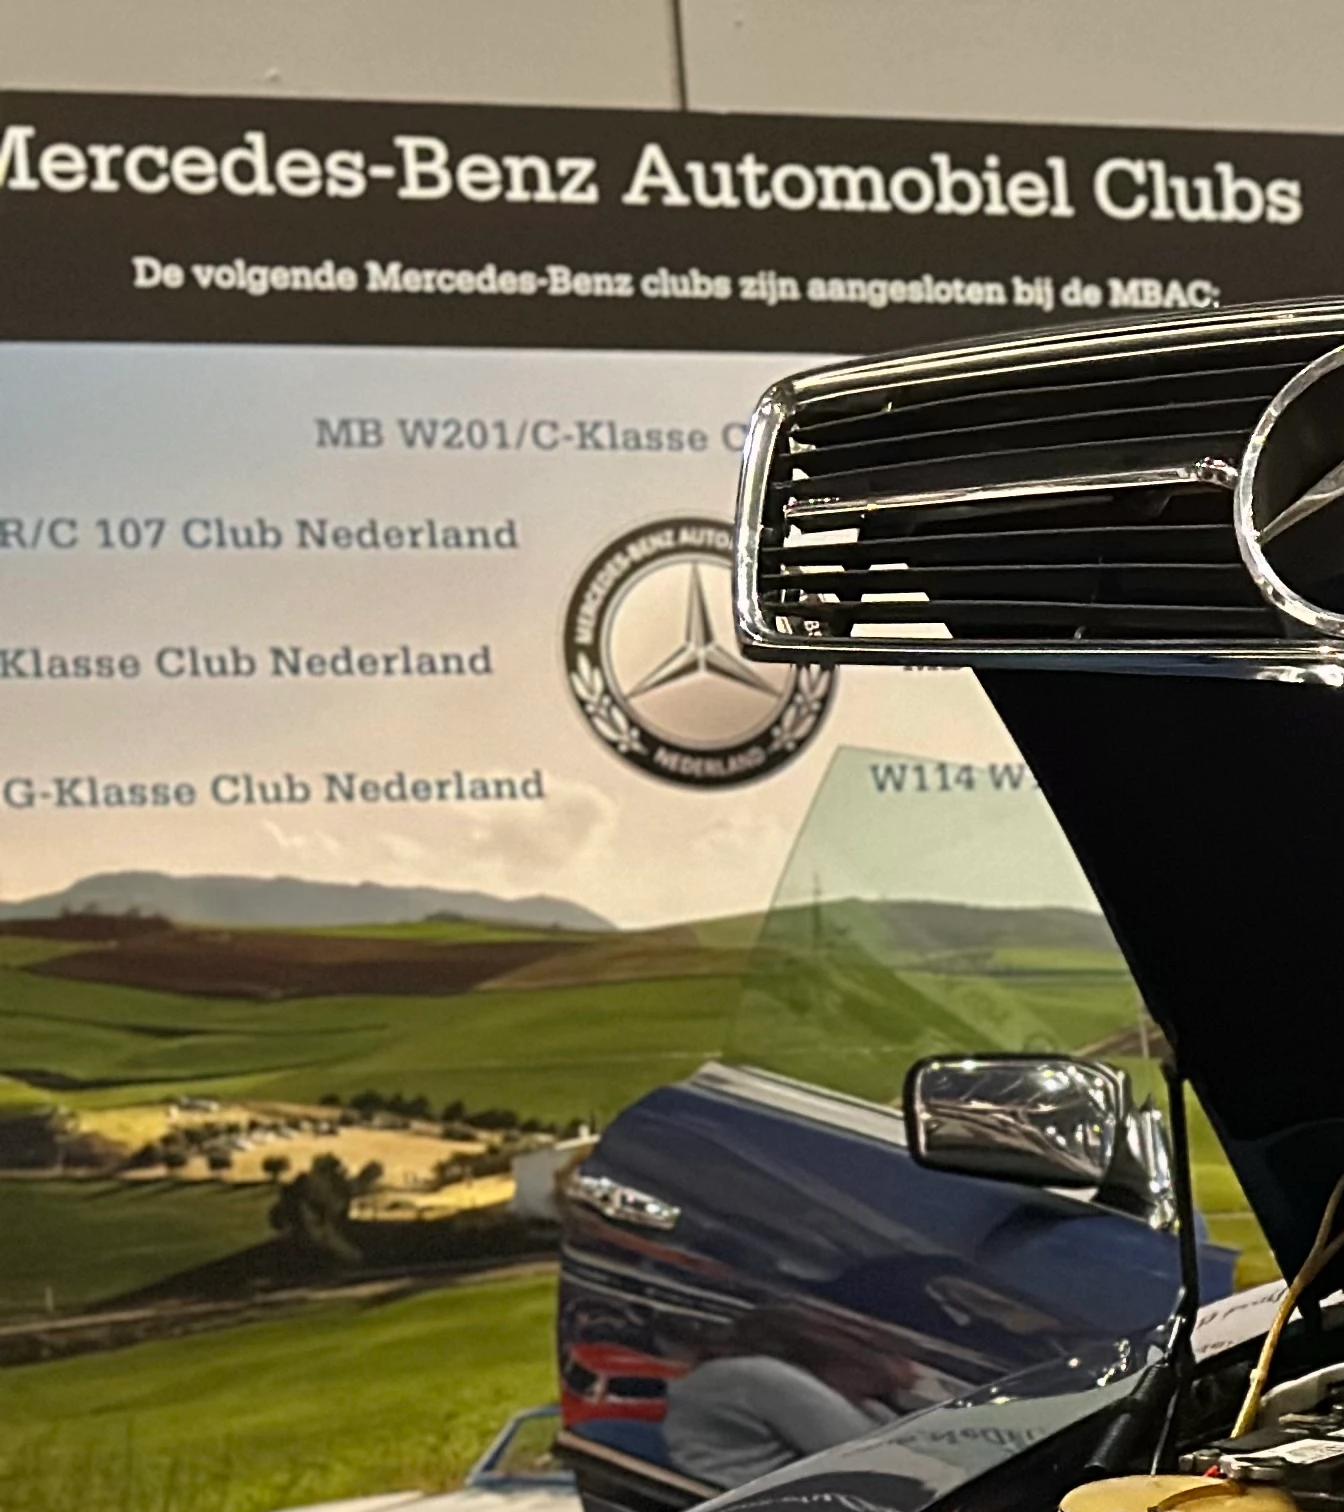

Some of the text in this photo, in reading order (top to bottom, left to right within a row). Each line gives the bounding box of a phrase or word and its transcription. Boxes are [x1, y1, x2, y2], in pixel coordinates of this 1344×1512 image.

[622, 144, 1074, 216] Automobiel
[1095, 159, 1301, 223] Clubs
[133, 257, 1220, 311] De volgende Mercedes-Benz clubs zijn aangesloten bij de MBAC:
[315, 417, 384, 448] MB
[397, 418, 707, 451] W201/C-Klasse
[96, 517, 166, 550] 107
[182, 518, 283, 550] Club
[297, 519, 519, 550] Nederland
[155, 646, 257, 679] Club
[270, 645, 494, 678] Nederland
[3, 769, 545, 810] G-Klasse Club Nederland
[869, 762, 975, 792] W114
